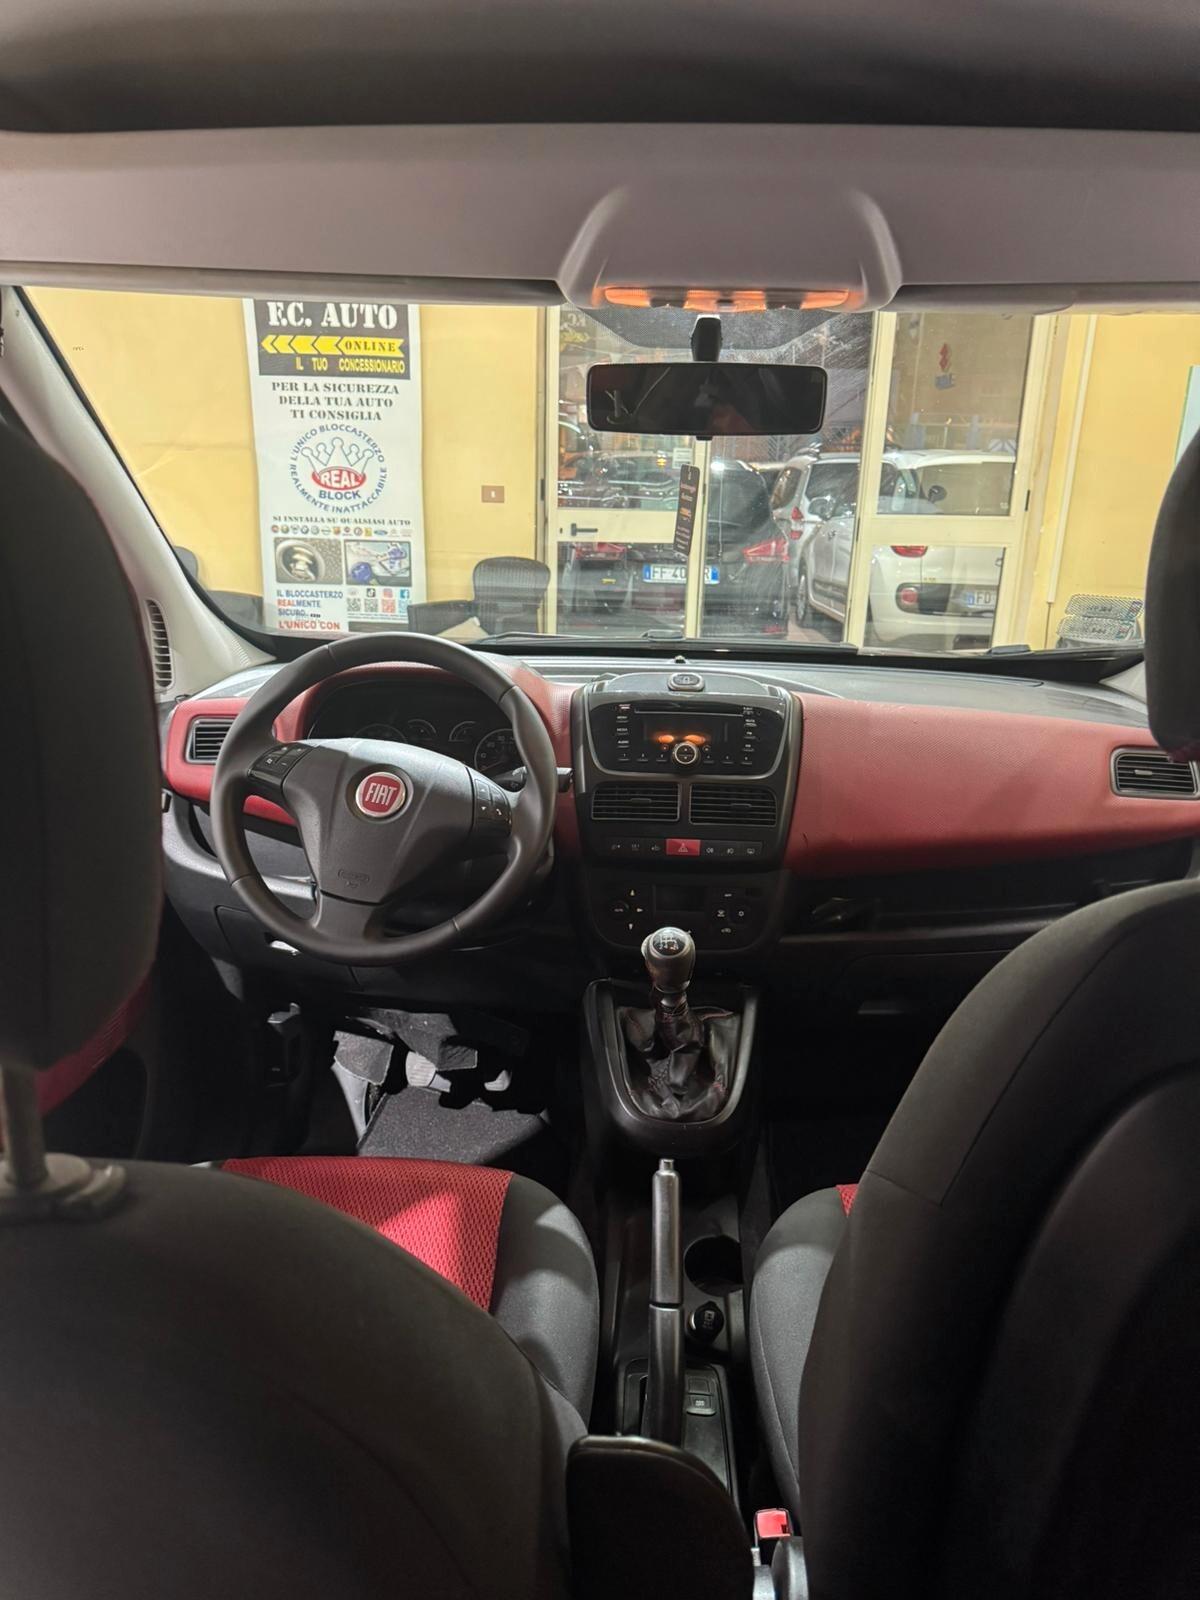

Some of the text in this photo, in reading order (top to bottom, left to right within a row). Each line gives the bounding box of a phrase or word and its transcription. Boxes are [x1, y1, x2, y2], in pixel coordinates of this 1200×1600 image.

[266, 301, 398, 330] F.C. AUTO
[345, 340, 396, 353] ONLINE
[296, 357, 406, 374] IL TUO CONCESSIONARIO
[271, 381, 400, 395] PER LA SICUREZZA
[279, 395, 393, 408] DELLA TUA AUTO
[290, 409, 382, 421] TI CONSIGLIA
[290, 423, 385, 463] L'UNICO BLOCCASTERZO
[320, 469, 361, 489] REAL
[290, 463, 388, 514] REALMENTE INATTACCABILE
[318, 489, 362, 500] BLOCK
[283, 515, 325, 524] INSTALLA
[340, 517, 386, 526] QUALSIASI
[387, 519, 412, 527] AUTO
[276, 589, 344, 599] IL BLOCCASTERZO
[277, 599, 321, 608] REALMENTE
[278, 620, 341, 630] L'UNICO CON
[365, 782, 398, 806] FIAT
